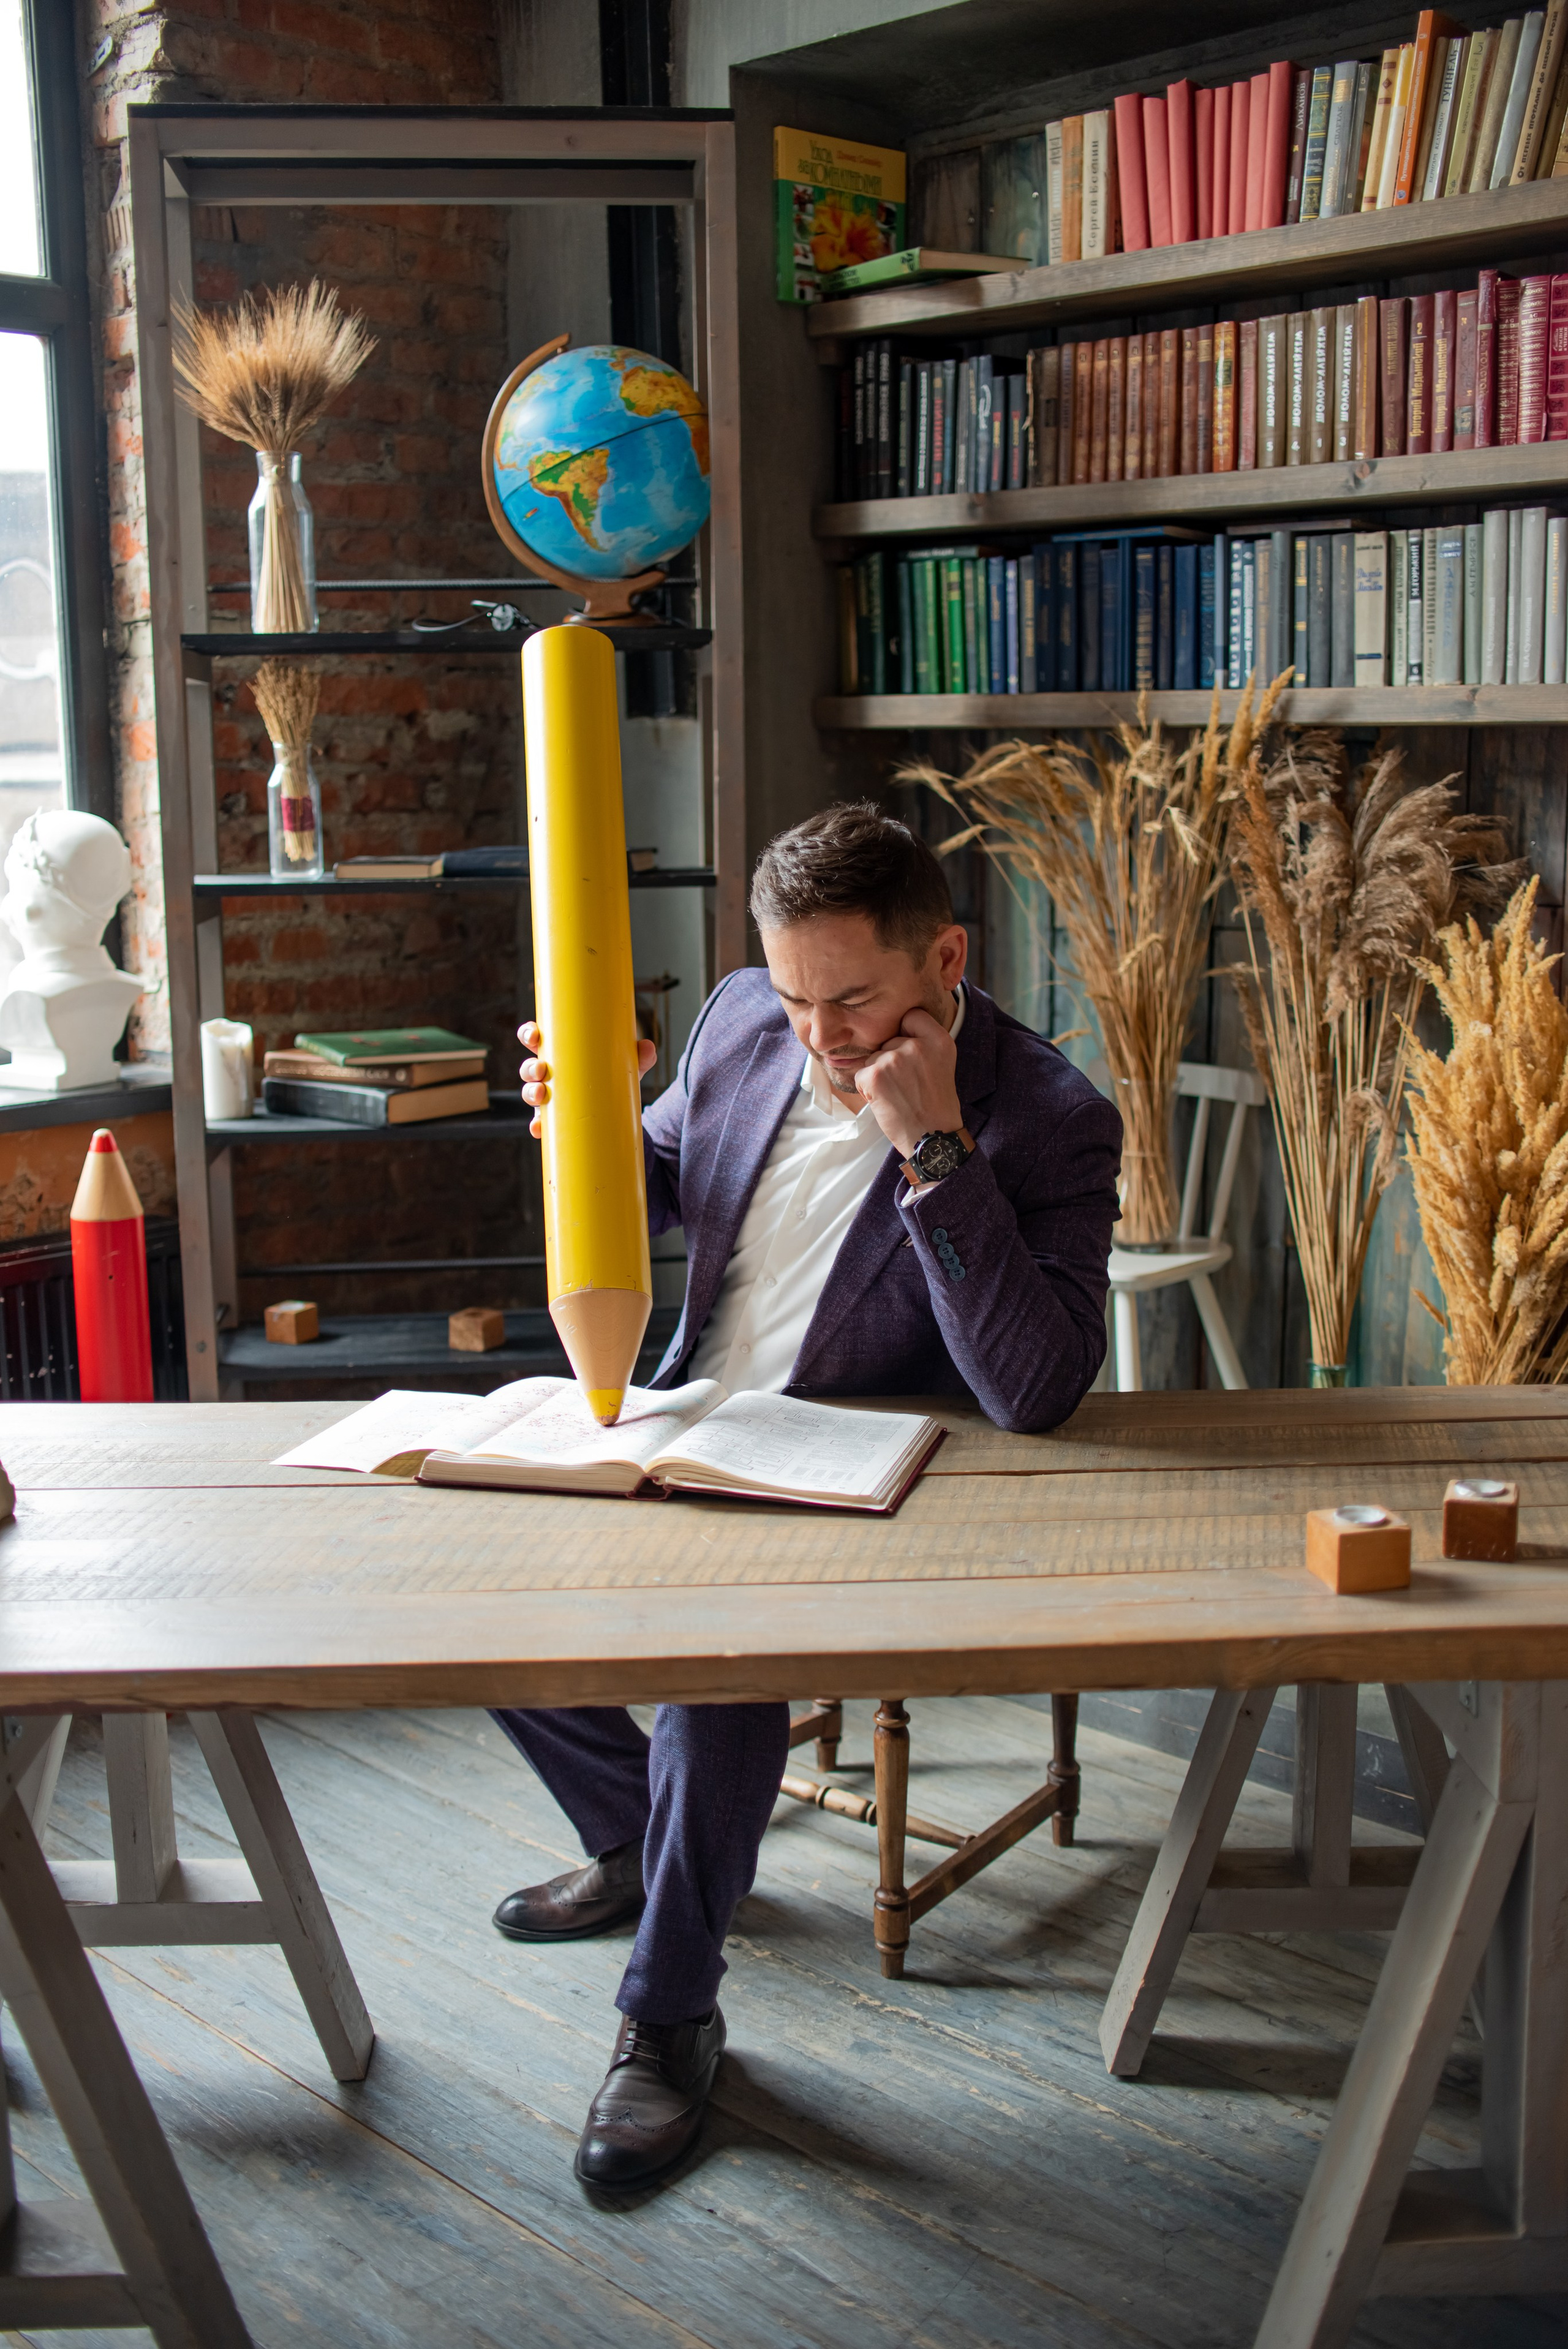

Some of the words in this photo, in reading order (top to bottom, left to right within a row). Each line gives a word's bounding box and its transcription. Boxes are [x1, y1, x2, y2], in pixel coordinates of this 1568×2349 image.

[1441, 50, 1458, 104] ТУННЕЛЬ
[1295, 82, 1306, 130] ЛИХАНОВ
[1333, 105, 1343, 146] СПАРТАК
[1400, 137, 1412, 181] Путеводитель
[1409, 76, 1420, 128] корпоративным
[1521, 132, 1532, 163] ПЕРВЫХ
[1529, 87, 1542, 129] ПРОТАЛИН
[1089, 140, 1098, 194] Есенин
[1088, 200, 1100, 248] Сергей
[1416, 322, 1423, 334] 2
[1267, 332, 1275, 427] ШОЛОМ-АЛЕЙХЕМ
[1292, 330, 1303, 428] ШОЛОМ-АЛЕЙХЕМ
[1316, 326, 1326, 423] ШОЛОМ-АЛЕЙХЕМ
[1340, 325, 1352, 421] ШОЛОМ-АЛЕЙХЕМ
[1411, 342, 1424, 397] Медынский
[1436, 338, 1448, 392] Медынский
[1479, 350, 1488, 396] ТОЛСТОЙ
[1409, 399, 1425, 437] Григорий
[1434, 395, 1448, 434] Григорий
[1267, 441, 1273, 452] 5
[1291, 441, 1300, 451] 4
[1317, 437, 1322, 448] 1
[1339, 436, 1346, 447] 3
[1411, 545, 1420, 596] М.ГОРЬКИЙ
